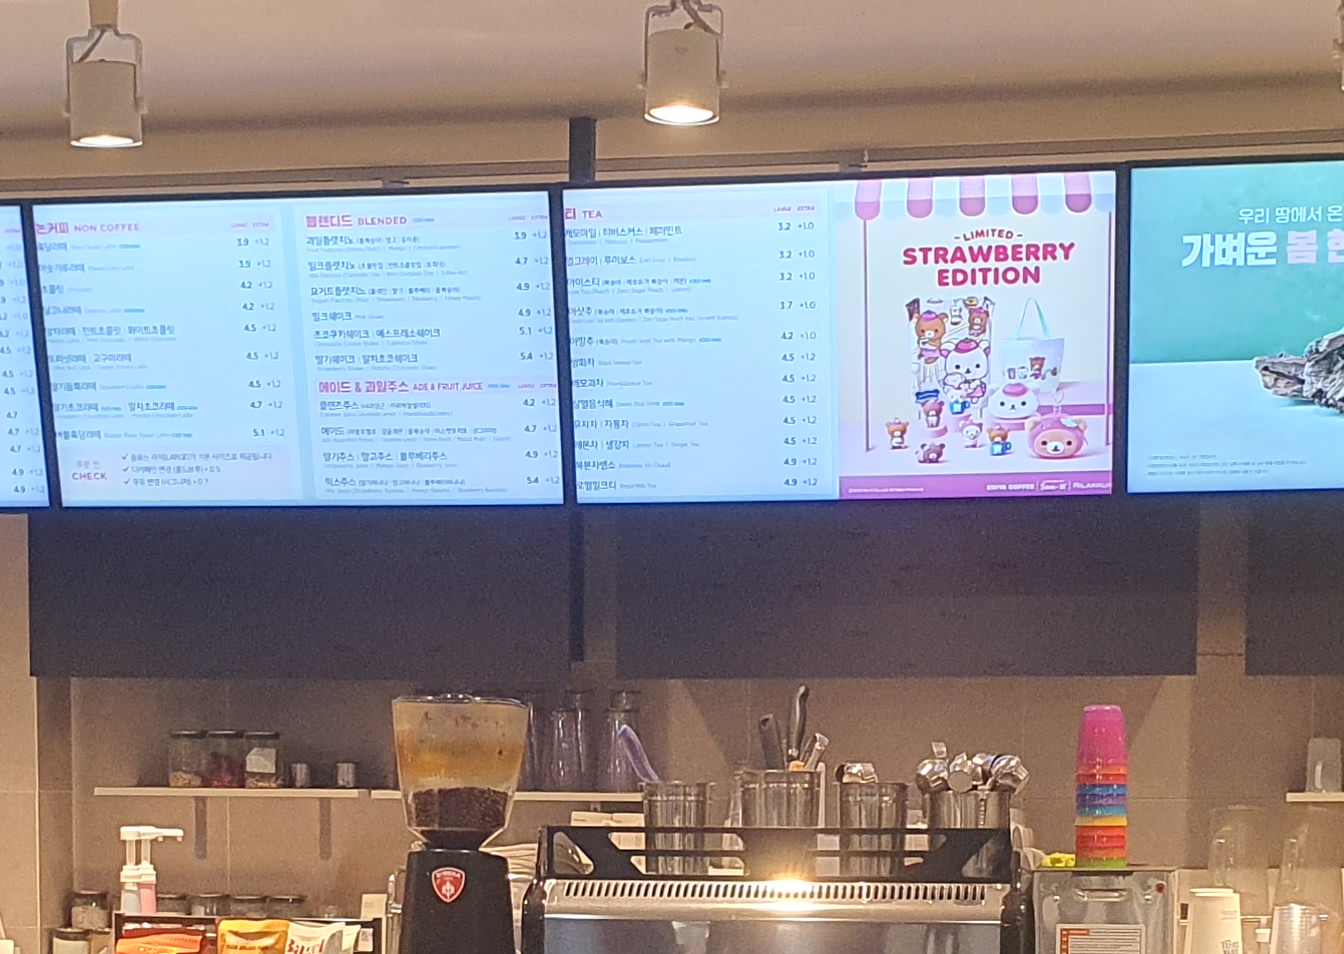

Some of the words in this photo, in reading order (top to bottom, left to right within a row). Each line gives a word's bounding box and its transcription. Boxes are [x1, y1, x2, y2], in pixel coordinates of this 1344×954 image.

[582, 210, 603, 219] TEA
[1238, 207, 1270, 224] 우리
[1275, 206, 1323, 224] 땅에서
[1326, 205, 1343, 222] 온
[306, 215, 353, 228] 블렌디드
[357, 216, 407, 226] BLENDED
[74, 224, 98, 232] NON
[100, 223, 140, 232] COFFEE
[778, 222, 791, 231] 3.2
[514, 232, 527, 240] 3.9
[962, 228, 1015, 242] LIMITED
[1181, 231, 1278, 268] 가벼운
[1286, 230, 1318, 264] 봄
[778, 250, 792, 259] 3.2
[902, 242, 1076, 266] STRAWBERRY
[515, 257, 528, 265] 4.7
[779, 272, 793, 281] 3.2
[937, 266, 1041, 287] EDITION
[516, 282, 530, 291] 4.9
[779, 301, 793, 310] 3.7
[518, 308, 531, 317] 4.9
[519, 327, 532, 335] 5.1
[781, 331, 794, 340] 4.2
[520, 352, 533, 361] 5.4
[781, 353, 795, 362] 4.5
[782, 374, 795, 383] 4.5
[319, 381, 352, 393] 에이드
[365, 380, 409, 393] 과일주스
[413, 382, 428, 391] ADE
[437, 382, 460, 391] FRUIT
[462, 382, 483, 390] JUICE
[523, 399, 536, 407] 4.2
[782, 395, 796, 404] 4.5
[783, 416, 796, 425] 4.5
[524, 424, 537, 433] 4.7
[783, 437, 796, 445] 4.5
[525, 450, 539, 459] 4.9
[783, 458, 797, 466] 4.9
[72, 473, 107, 481] CHECK
[526, 476, 539, 485] 5.4
[784, 478, 798, 487] 4.9
